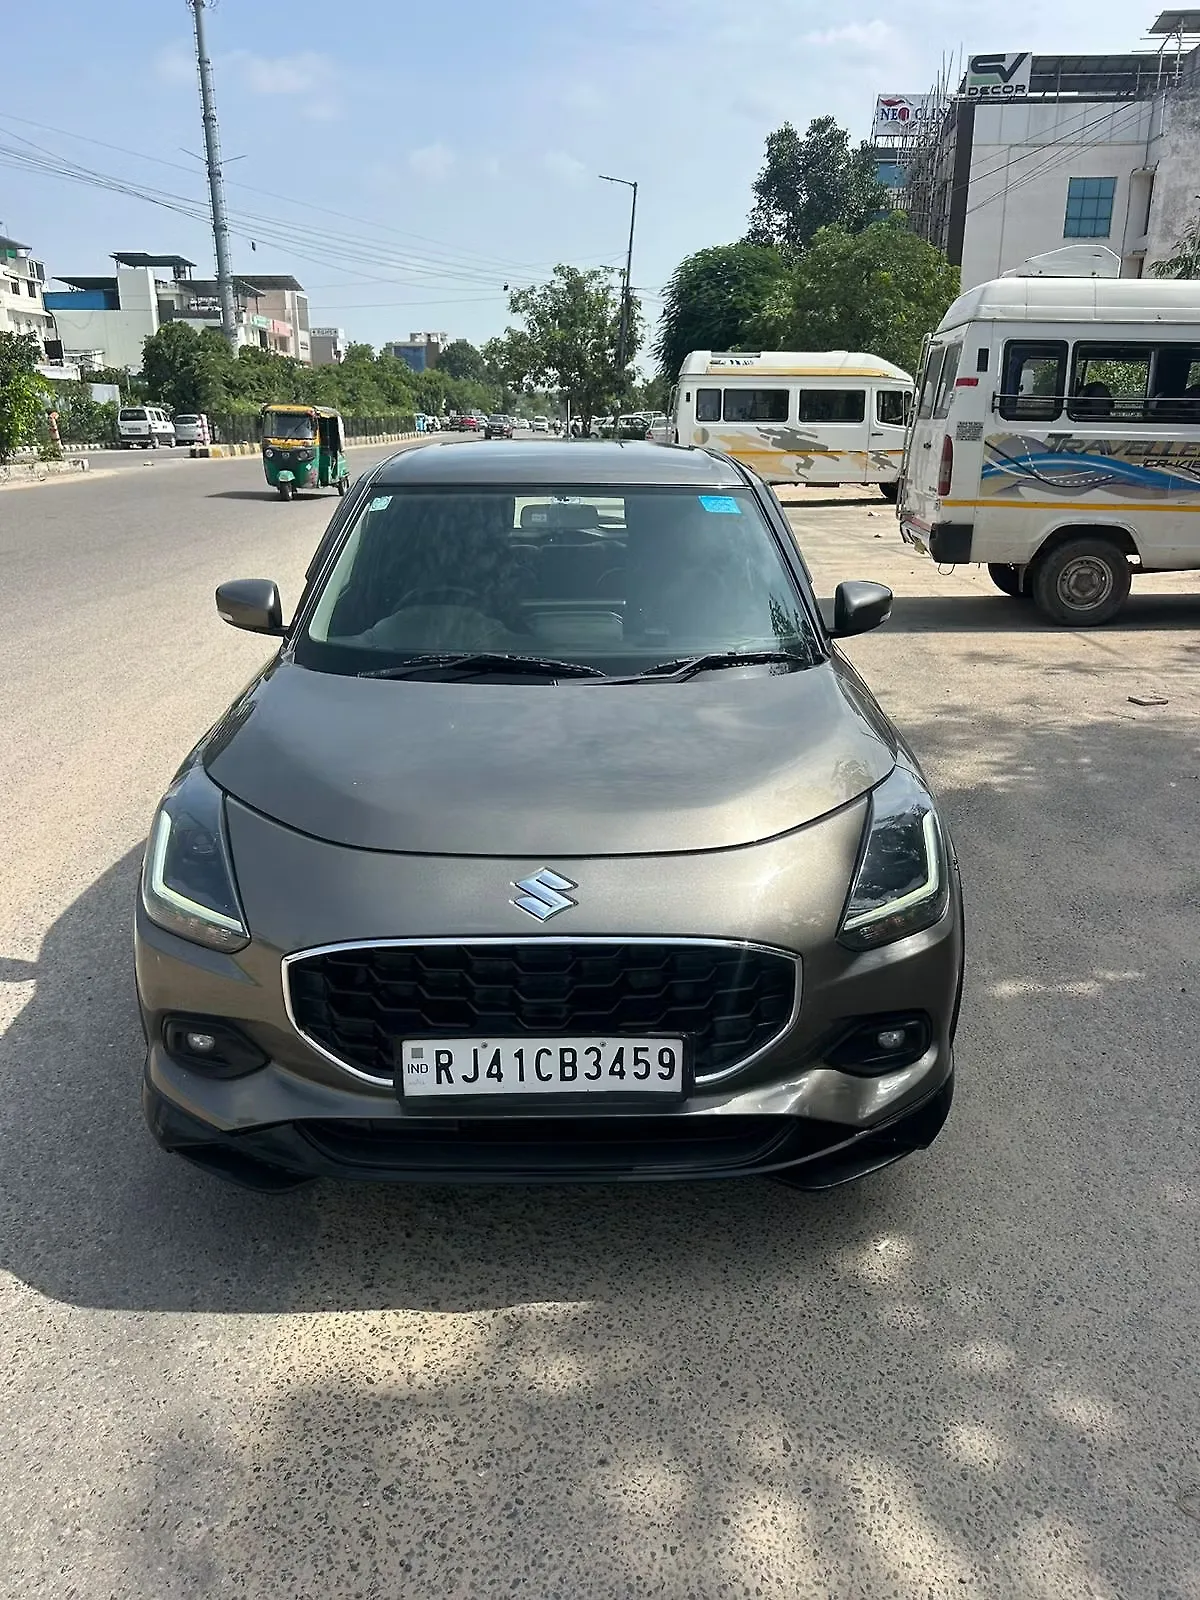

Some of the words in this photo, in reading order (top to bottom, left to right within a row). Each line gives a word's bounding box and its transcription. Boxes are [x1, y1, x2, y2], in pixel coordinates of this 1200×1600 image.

[968, 84, 1026, 96] DECOR
[880, 107, 910, 121] NEO
[407, 1063, 429, 1074] IND
[434, 1046, 677, 1085] RJ41CB3459
